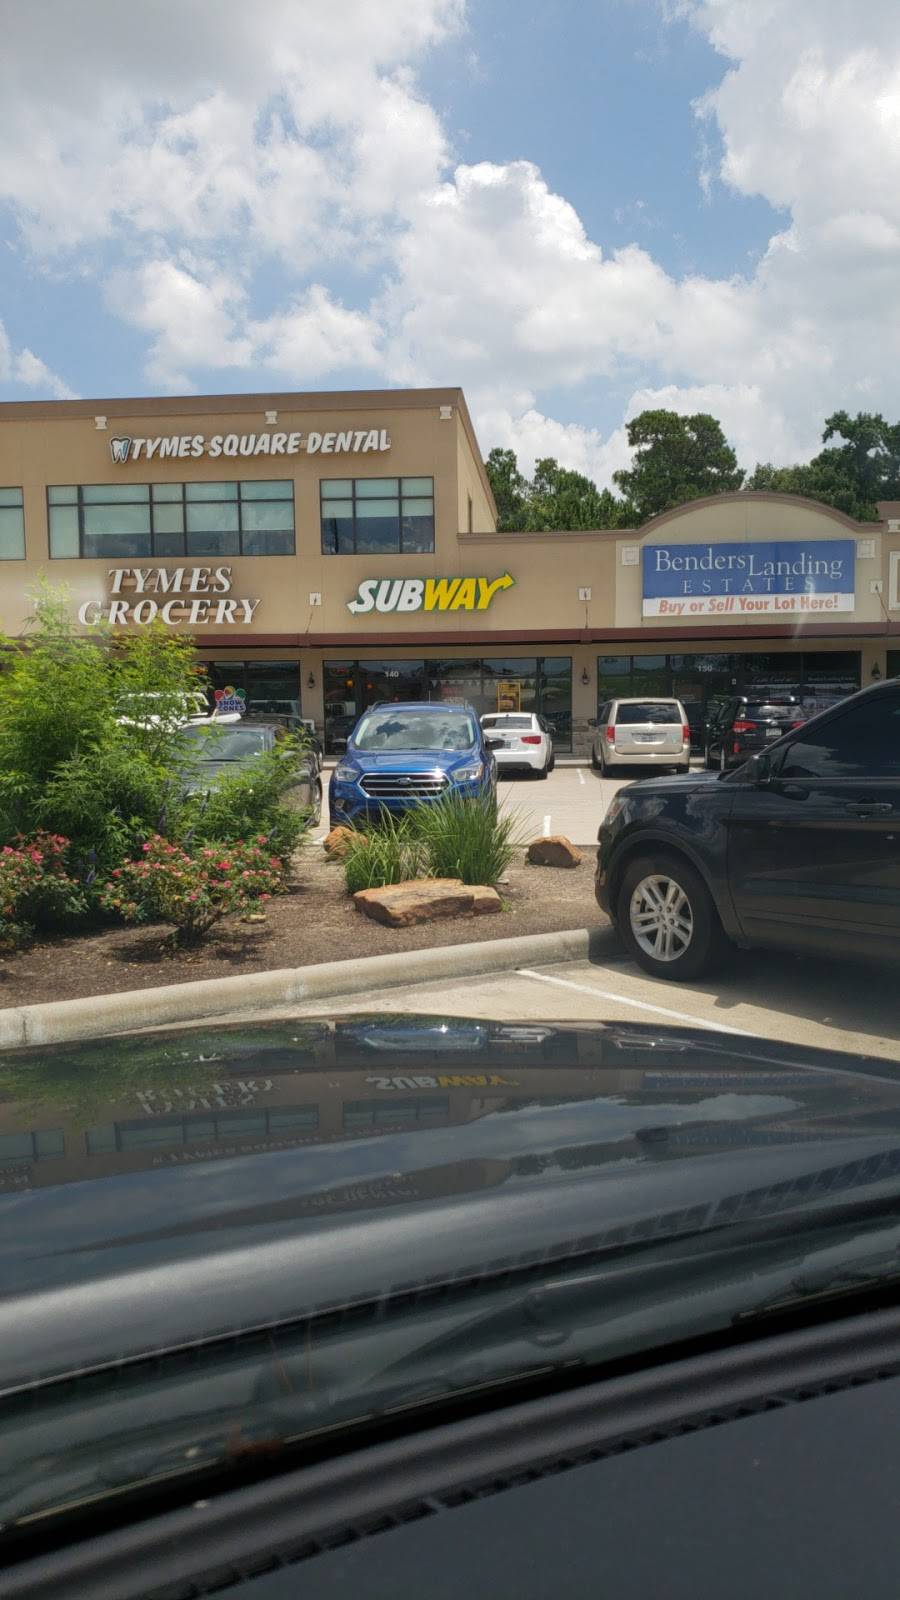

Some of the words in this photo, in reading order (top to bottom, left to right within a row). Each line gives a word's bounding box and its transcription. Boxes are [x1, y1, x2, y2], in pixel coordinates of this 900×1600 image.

[131, 435, 204, 460] TYMES
[208, 432, 301, 457] SQUARE
[307, 429, 391, 453] DENTAL
[655, 547, 746, 572] Benders
[749, 552, 843, 580] Landing
[108, 567, 232, 594] TYMES
[347, 573, 514, 614] SUBWAY
[682, 575, 815, 594] ESTATES
[78, 599, 261, 625] GROCERY
[659, 600, 685, 614] Buy
[689, 602, 704, 612] or
[708, 597, 734, 611] Sell
[739, 597, 769, 611] Your
[774, 596, 795, 610] Lot
[800, 594, 839, 609] Here!
[384, 670, 399, 678] 140
